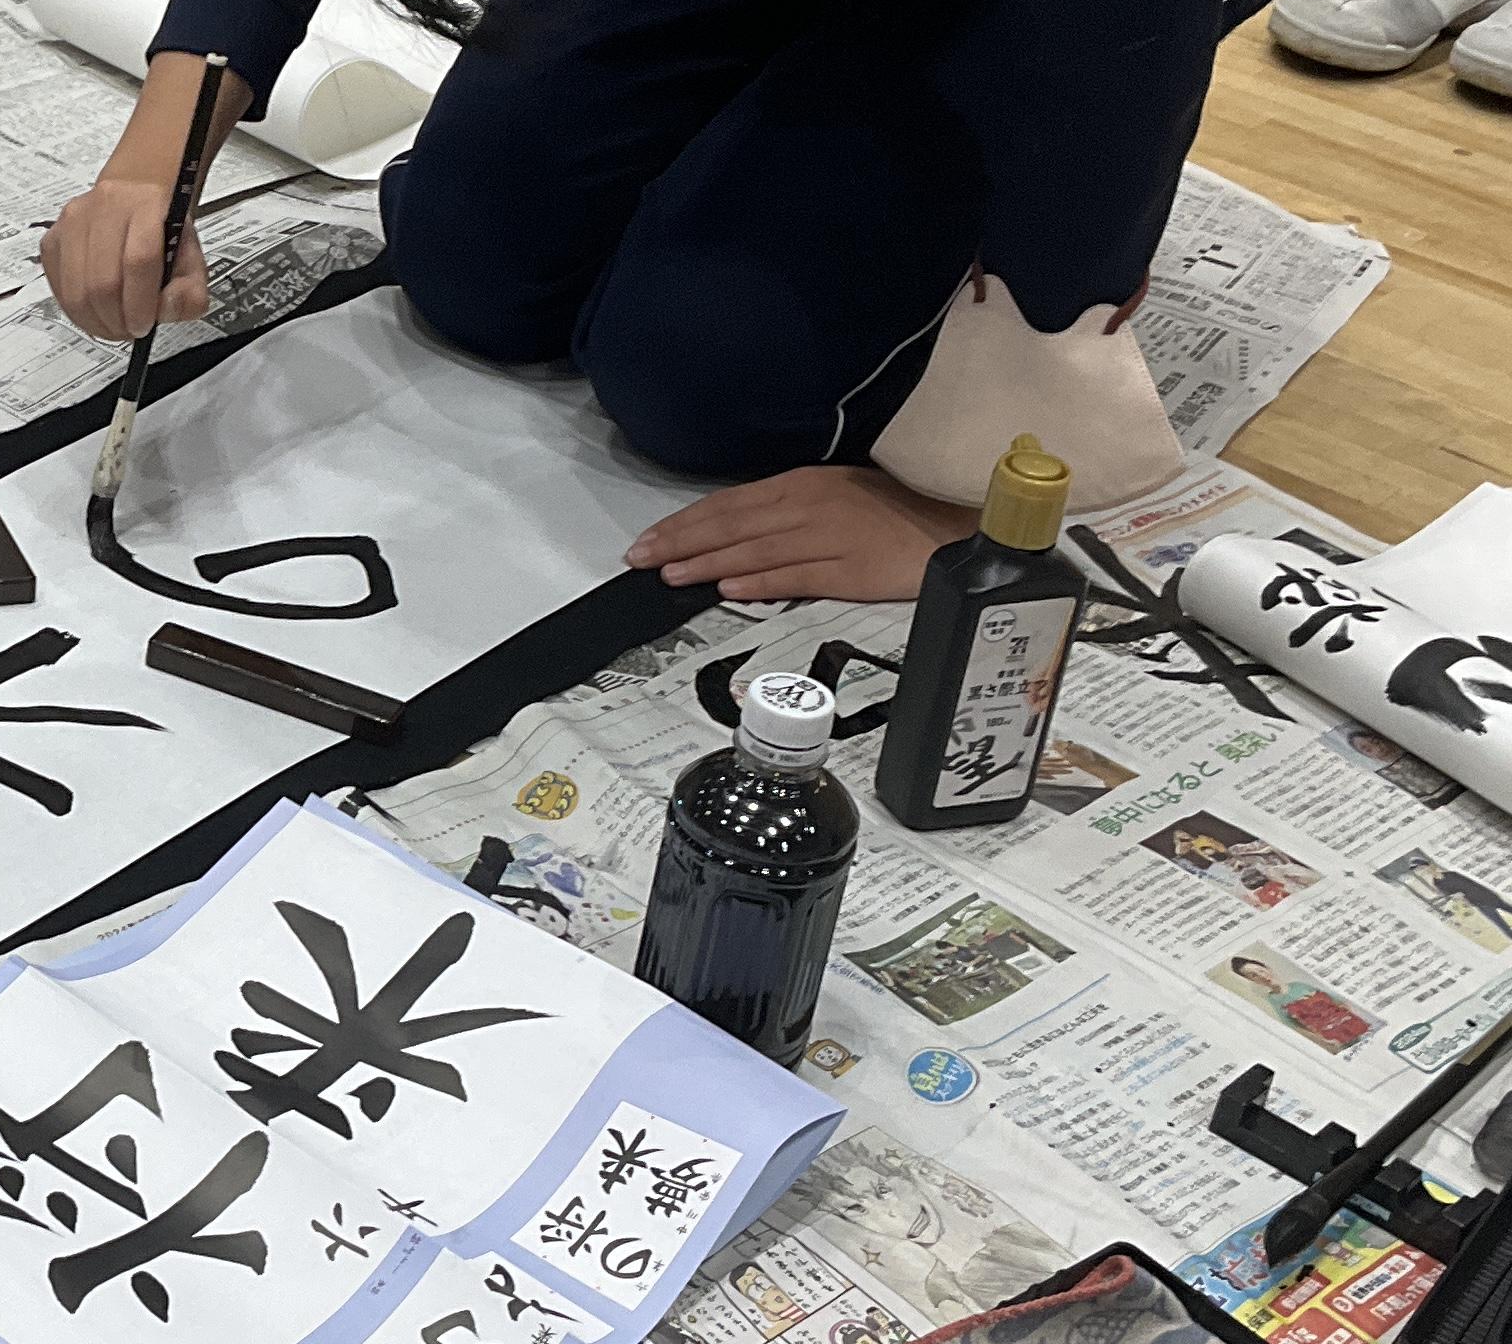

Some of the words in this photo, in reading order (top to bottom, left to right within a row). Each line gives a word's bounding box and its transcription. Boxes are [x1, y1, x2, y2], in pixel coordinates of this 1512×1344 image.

[1088, 760, 1224, 836] 夢中になると
[539, 1128, 666, 1254] 将来
[601, 1158, 716, 1278] の夢
